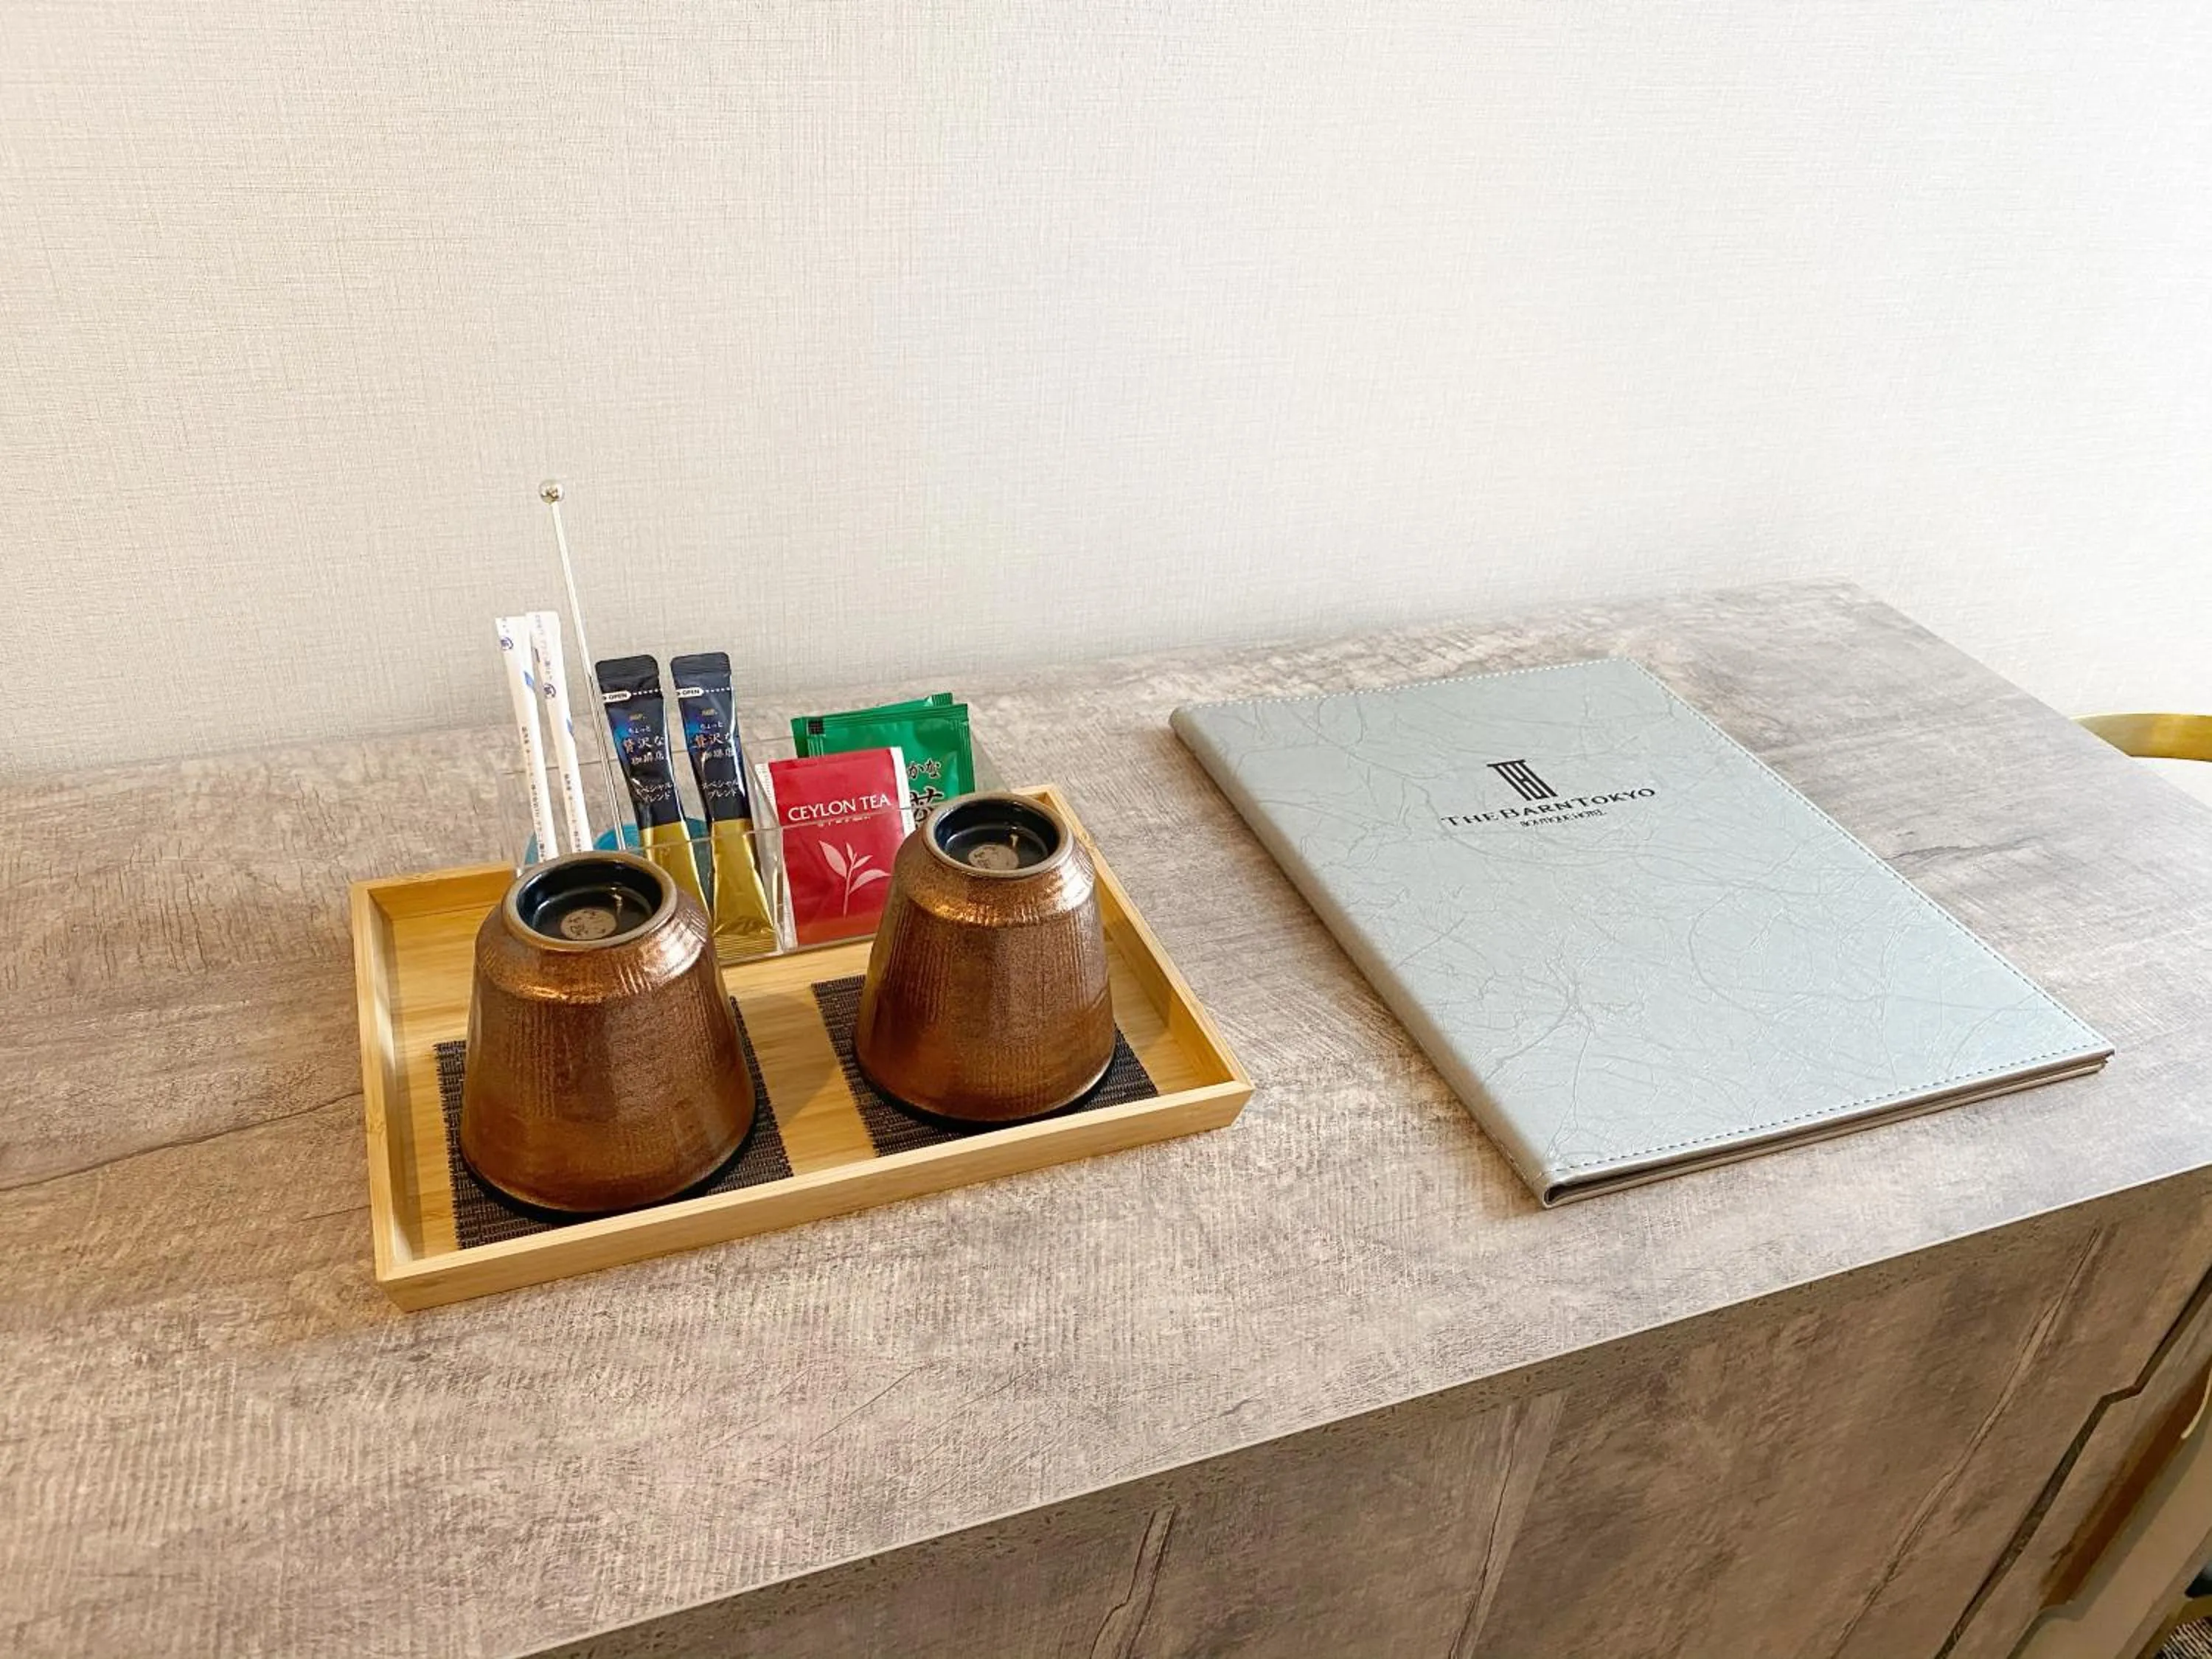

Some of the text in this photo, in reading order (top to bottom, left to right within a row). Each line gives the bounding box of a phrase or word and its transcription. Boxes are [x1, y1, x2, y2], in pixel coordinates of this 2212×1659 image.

[787, 798, 857, 821] CEYLON
[859, 793, 892, 811] TEA
[1440, 787, 1656, 827] THE BARN TOKYO
